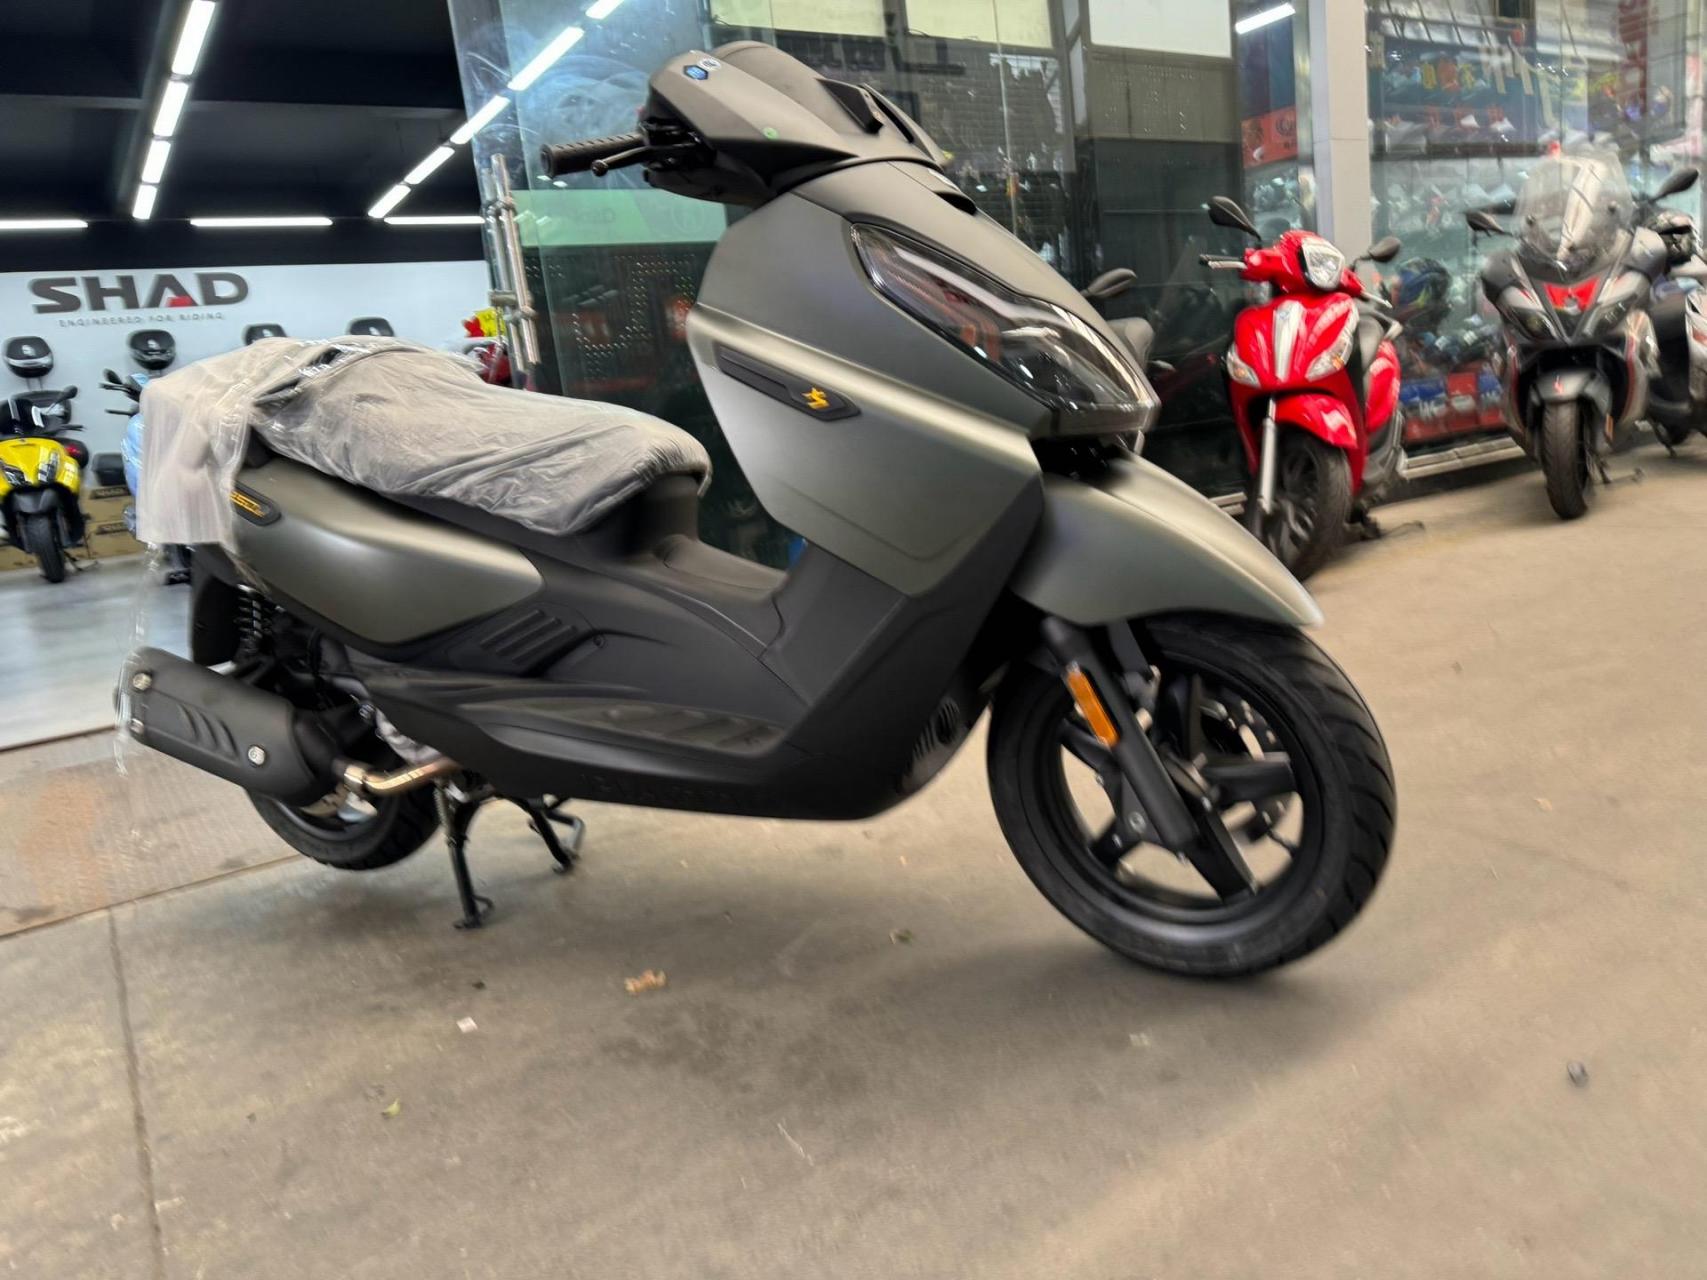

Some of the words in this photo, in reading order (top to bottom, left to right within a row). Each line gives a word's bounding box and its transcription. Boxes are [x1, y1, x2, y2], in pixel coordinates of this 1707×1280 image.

[29, 271, 249, 314] SHAD
[58, 316, 142, 328] ENGINEERED
[149, 315, 174, 323] FOR
[179, 311, 225, 321] RIDING
